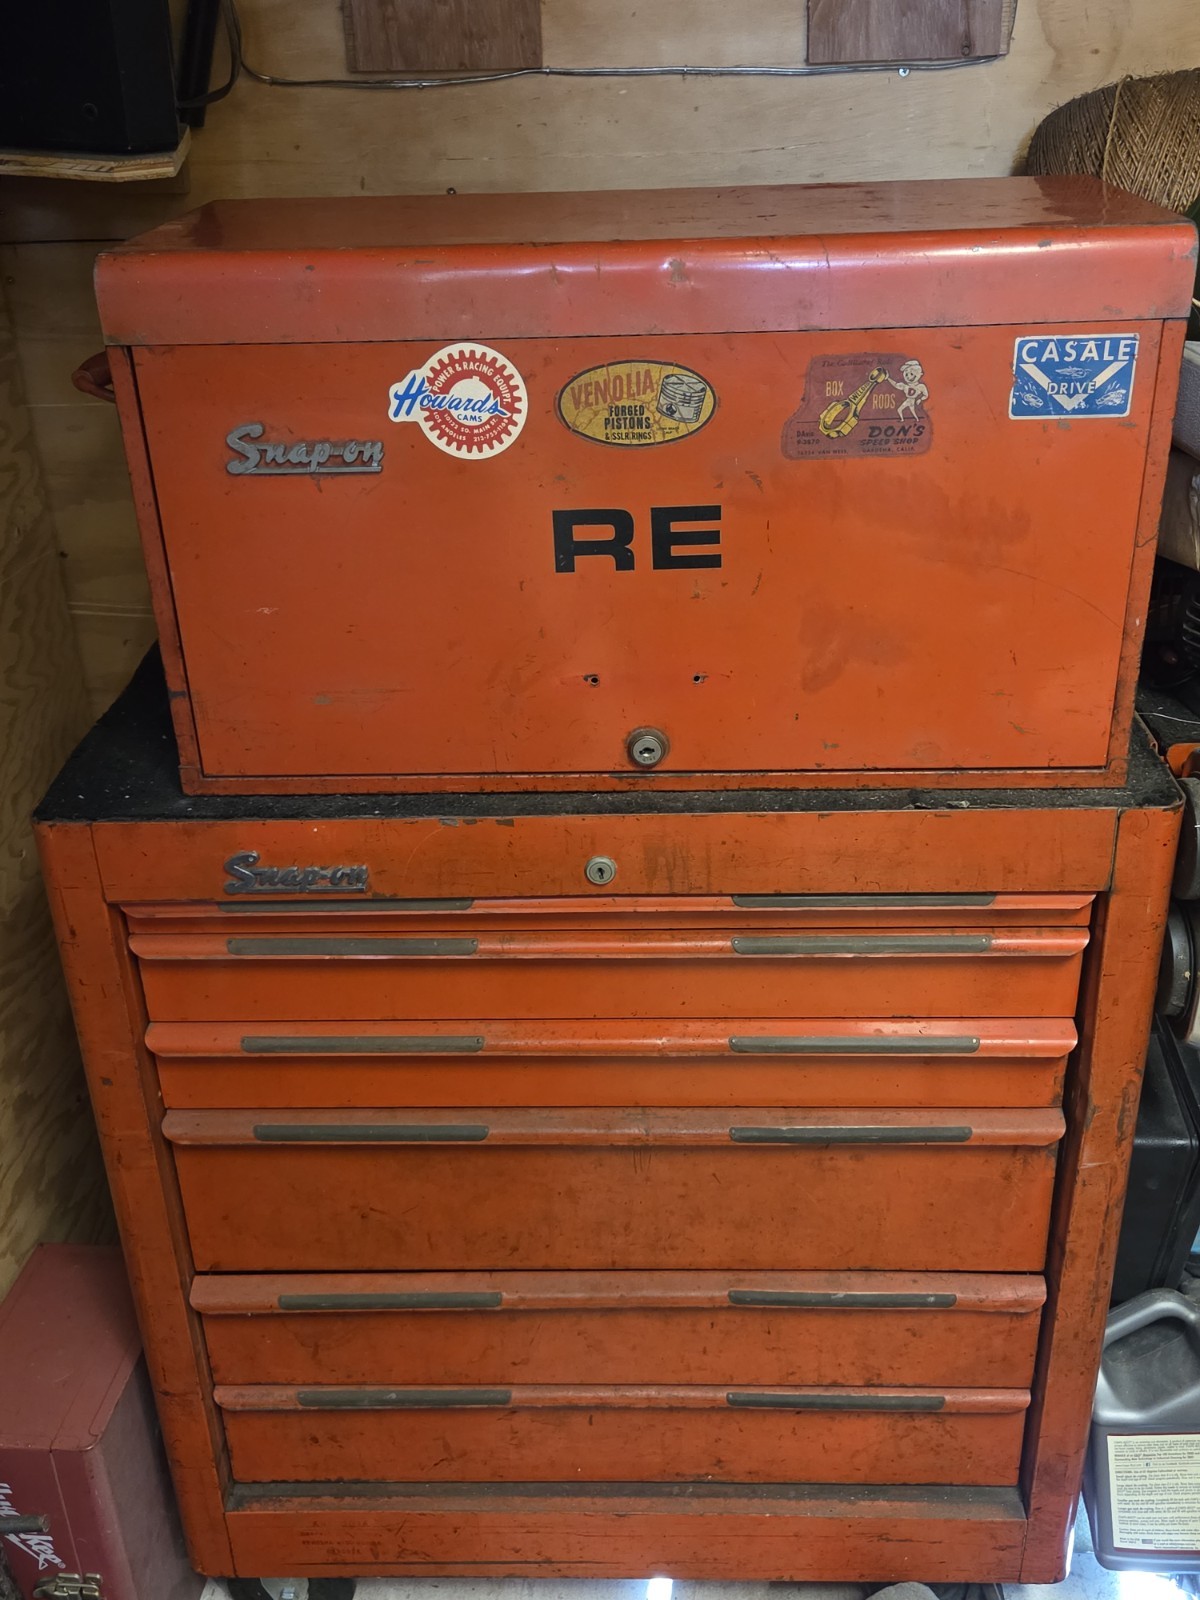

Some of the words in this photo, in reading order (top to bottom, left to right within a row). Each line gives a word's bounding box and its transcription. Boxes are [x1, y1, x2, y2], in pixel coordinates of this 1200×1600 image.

[1021, 339, 1131, 363] CASALE
[432, 366, 455, 392] POWER
[455, 363, 462, 372] &
[462, 361, 495, 376] RACING
[493, 374, 511, 405] EQUIPT.
[570, 368, 655, 410] VENOLIA
[825, 380, 844, 397] BOX
[1048, 382, 1096, 395] DRIVE
[393, 373, 508, 419] Howards
[872, 393, 896, 410] RODS
[456, 413, 483, 423] CAMS
[608, 405, 645, 416] FORGED
[433, 411, 442, 423] LOS
[440, 424, 467, 441] ANGELES
[473, 424, 491, 434] MAIN
[604, 416, 652, 430] PISTONS
[868, 423, 926, 438] DON'S
[604, 432, 610, 441] &
[631, 431, 652, 440] RINGS
[859, 438, 891, 446] SPEED
[893, 437, 919, 445] SHOP
[225, 422, 385, 475] Snap-on
[552, 504, 722, 573] RE
[223, 849, 369, 895] Snap-on
